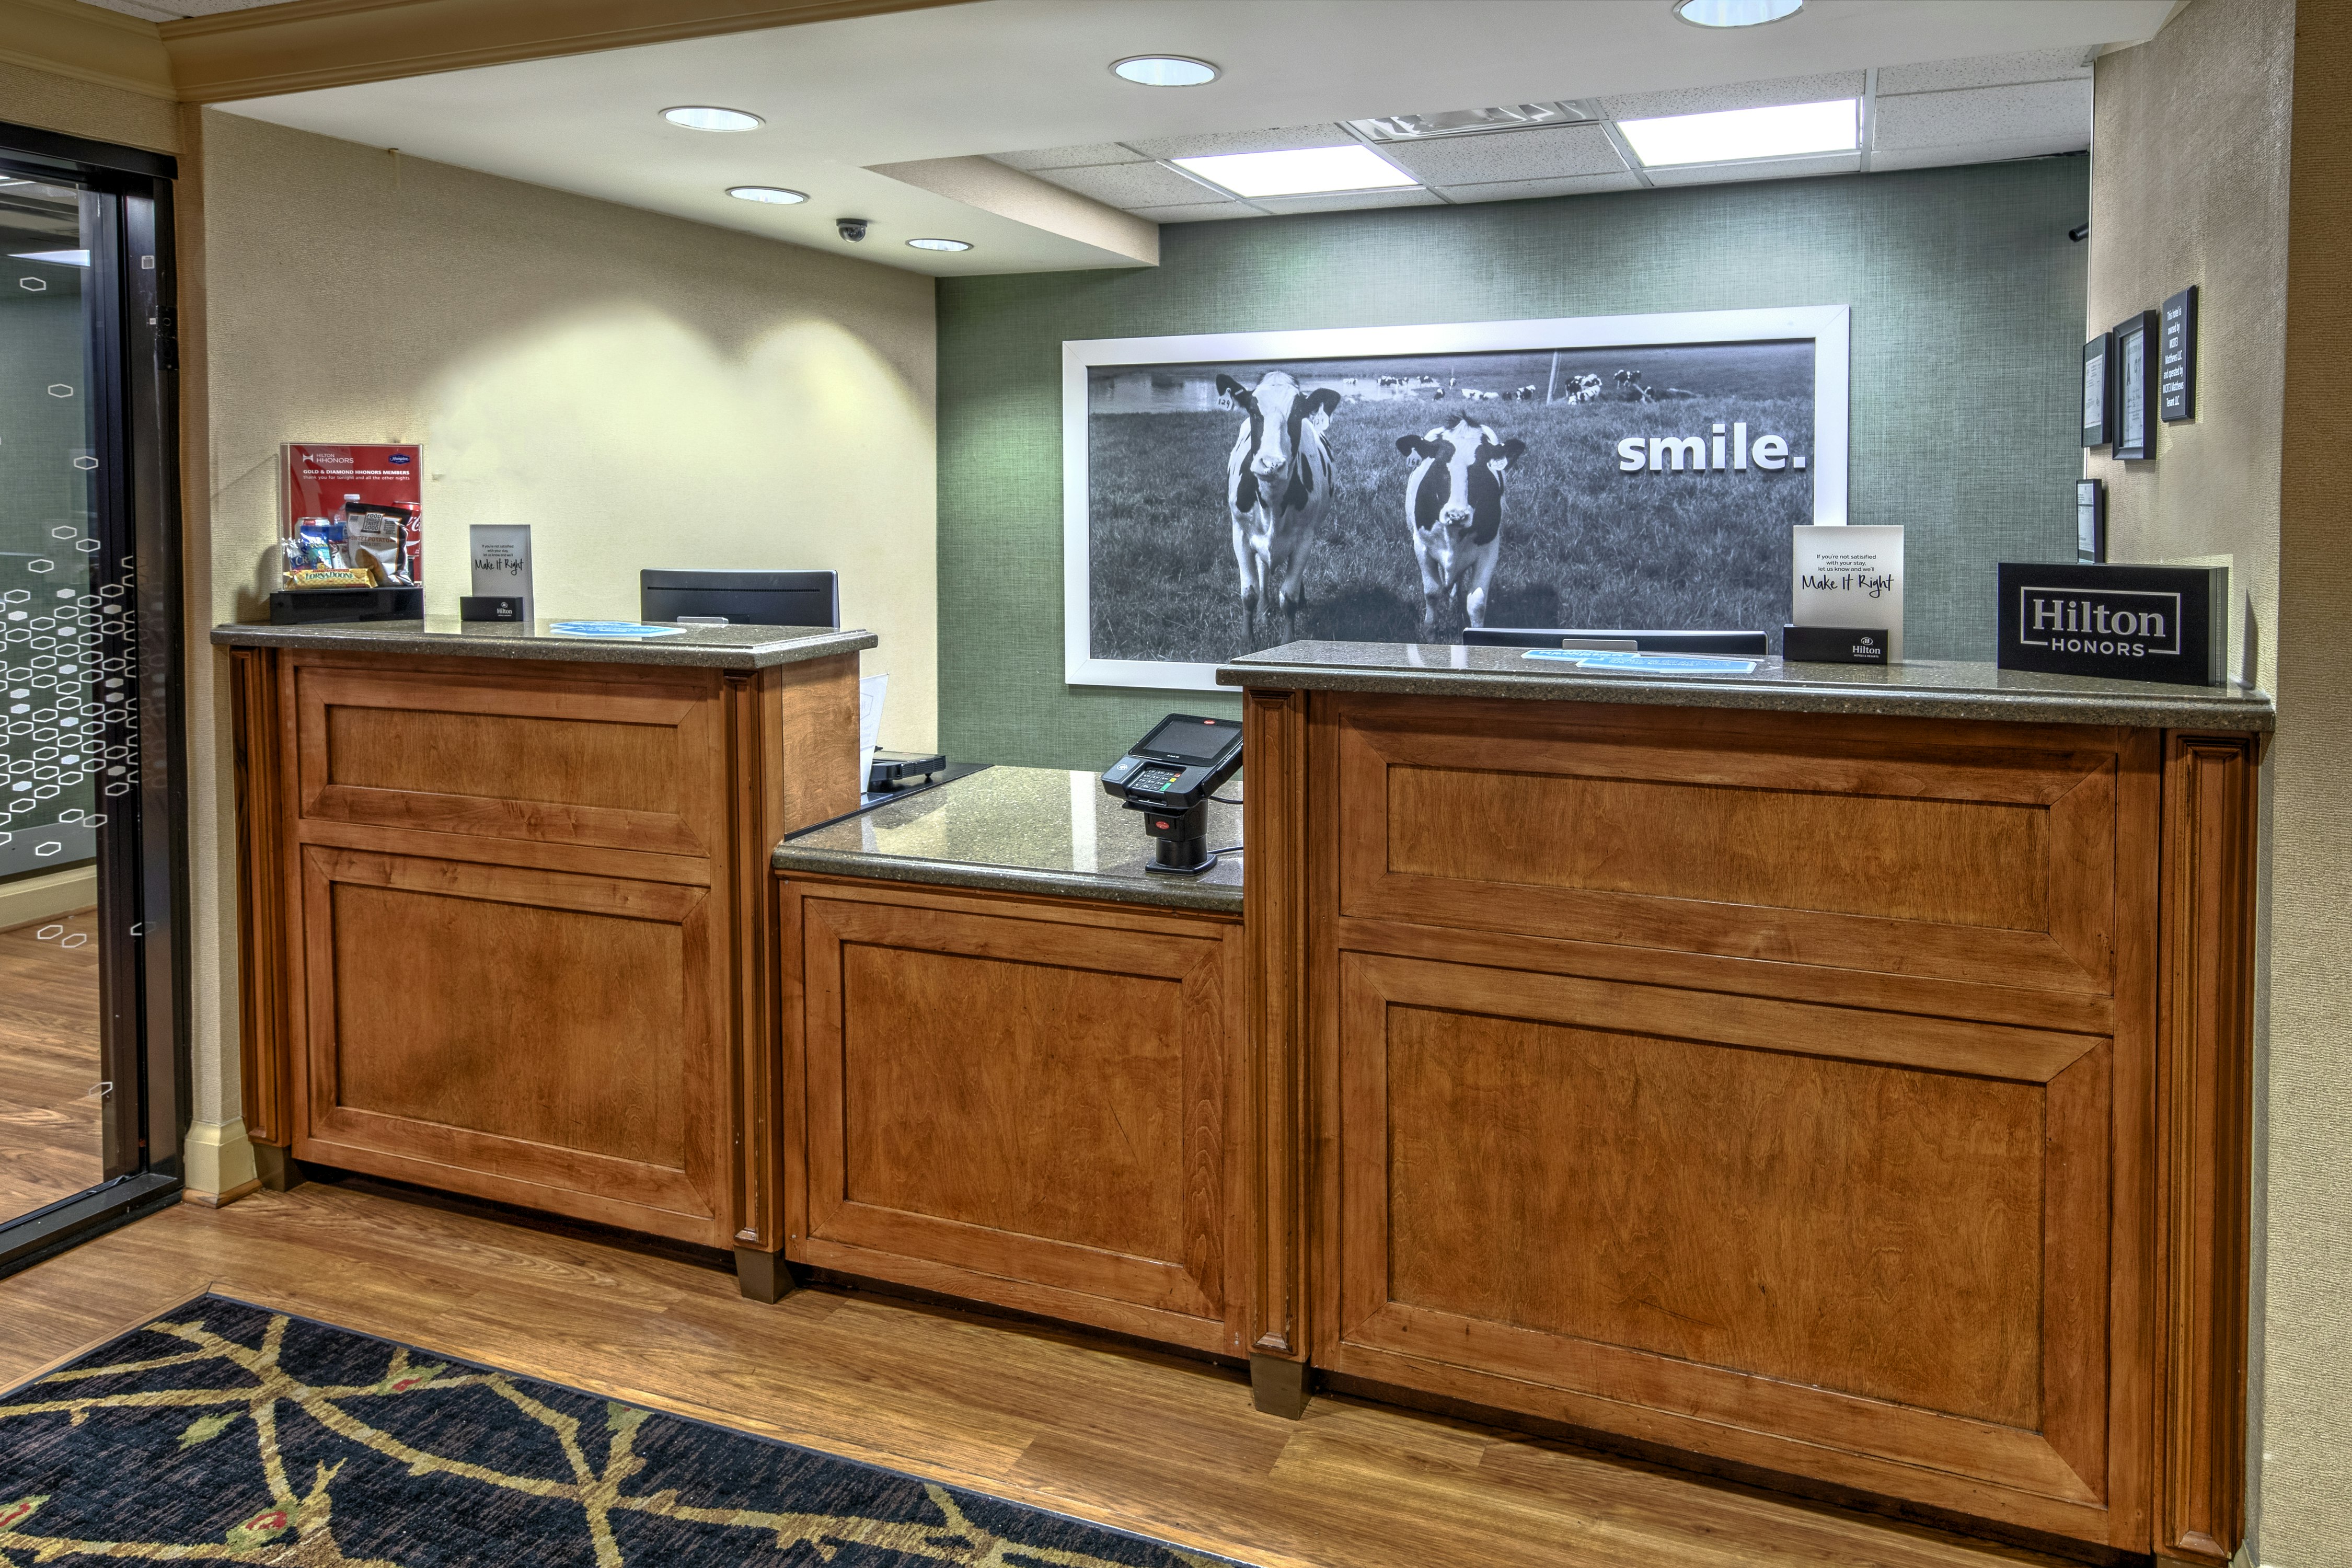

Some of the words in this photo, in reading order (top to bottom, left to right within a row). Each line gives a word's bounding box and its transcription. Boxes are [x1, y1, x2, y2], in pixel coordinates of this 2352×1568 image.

[2179, 306, 2182, 316] is
[2176, 321, 2180, 333] by
[2169, 365, 2180, 380] operated
[2180, 364, 2183, 377] by
[1218, 398, 1230, 409] 129
[2166, 397, 2175, 407] Tenant
[1617, 422, 1806, 471] smile.
[475, 559, 494, 570] Make
[497, 558, 502, 570] It
[504, 558, 524, 576] Right
[1802, 574, 1838, 590] Make
[1842, 574, 1853, 591] It
[1859, 574, 1895, 598] Right
[2033, 599, 2166, 637] Hilton
[1852, 645, 1881, 654] Hilton
[2052, 638, 2145, 656] HONORS
